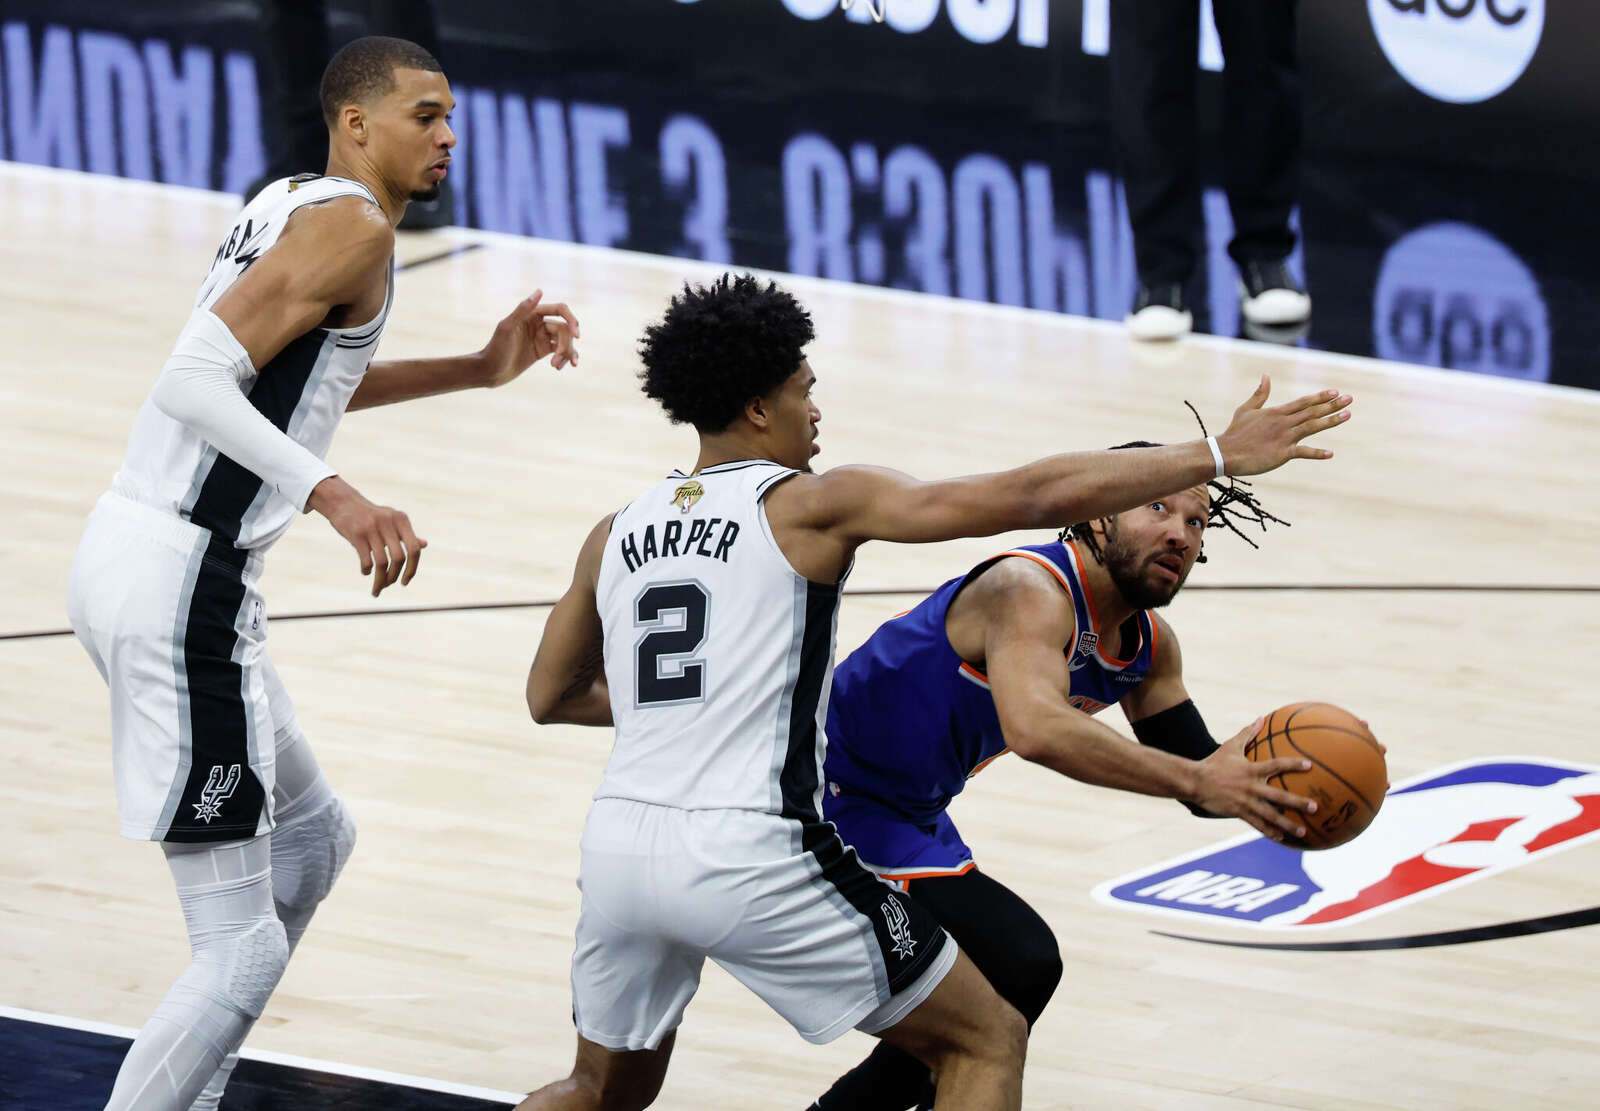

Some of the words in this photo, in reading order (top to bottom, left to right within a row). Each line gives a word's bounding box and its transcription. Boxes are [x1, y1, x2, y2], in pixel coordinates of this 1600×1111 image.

[669, 485, 705, 505] Finals
[621, 518, 740, 573] HARPER
[633, 577, 712, 710] 2
[1135, 869, 1300, 913] NBA
